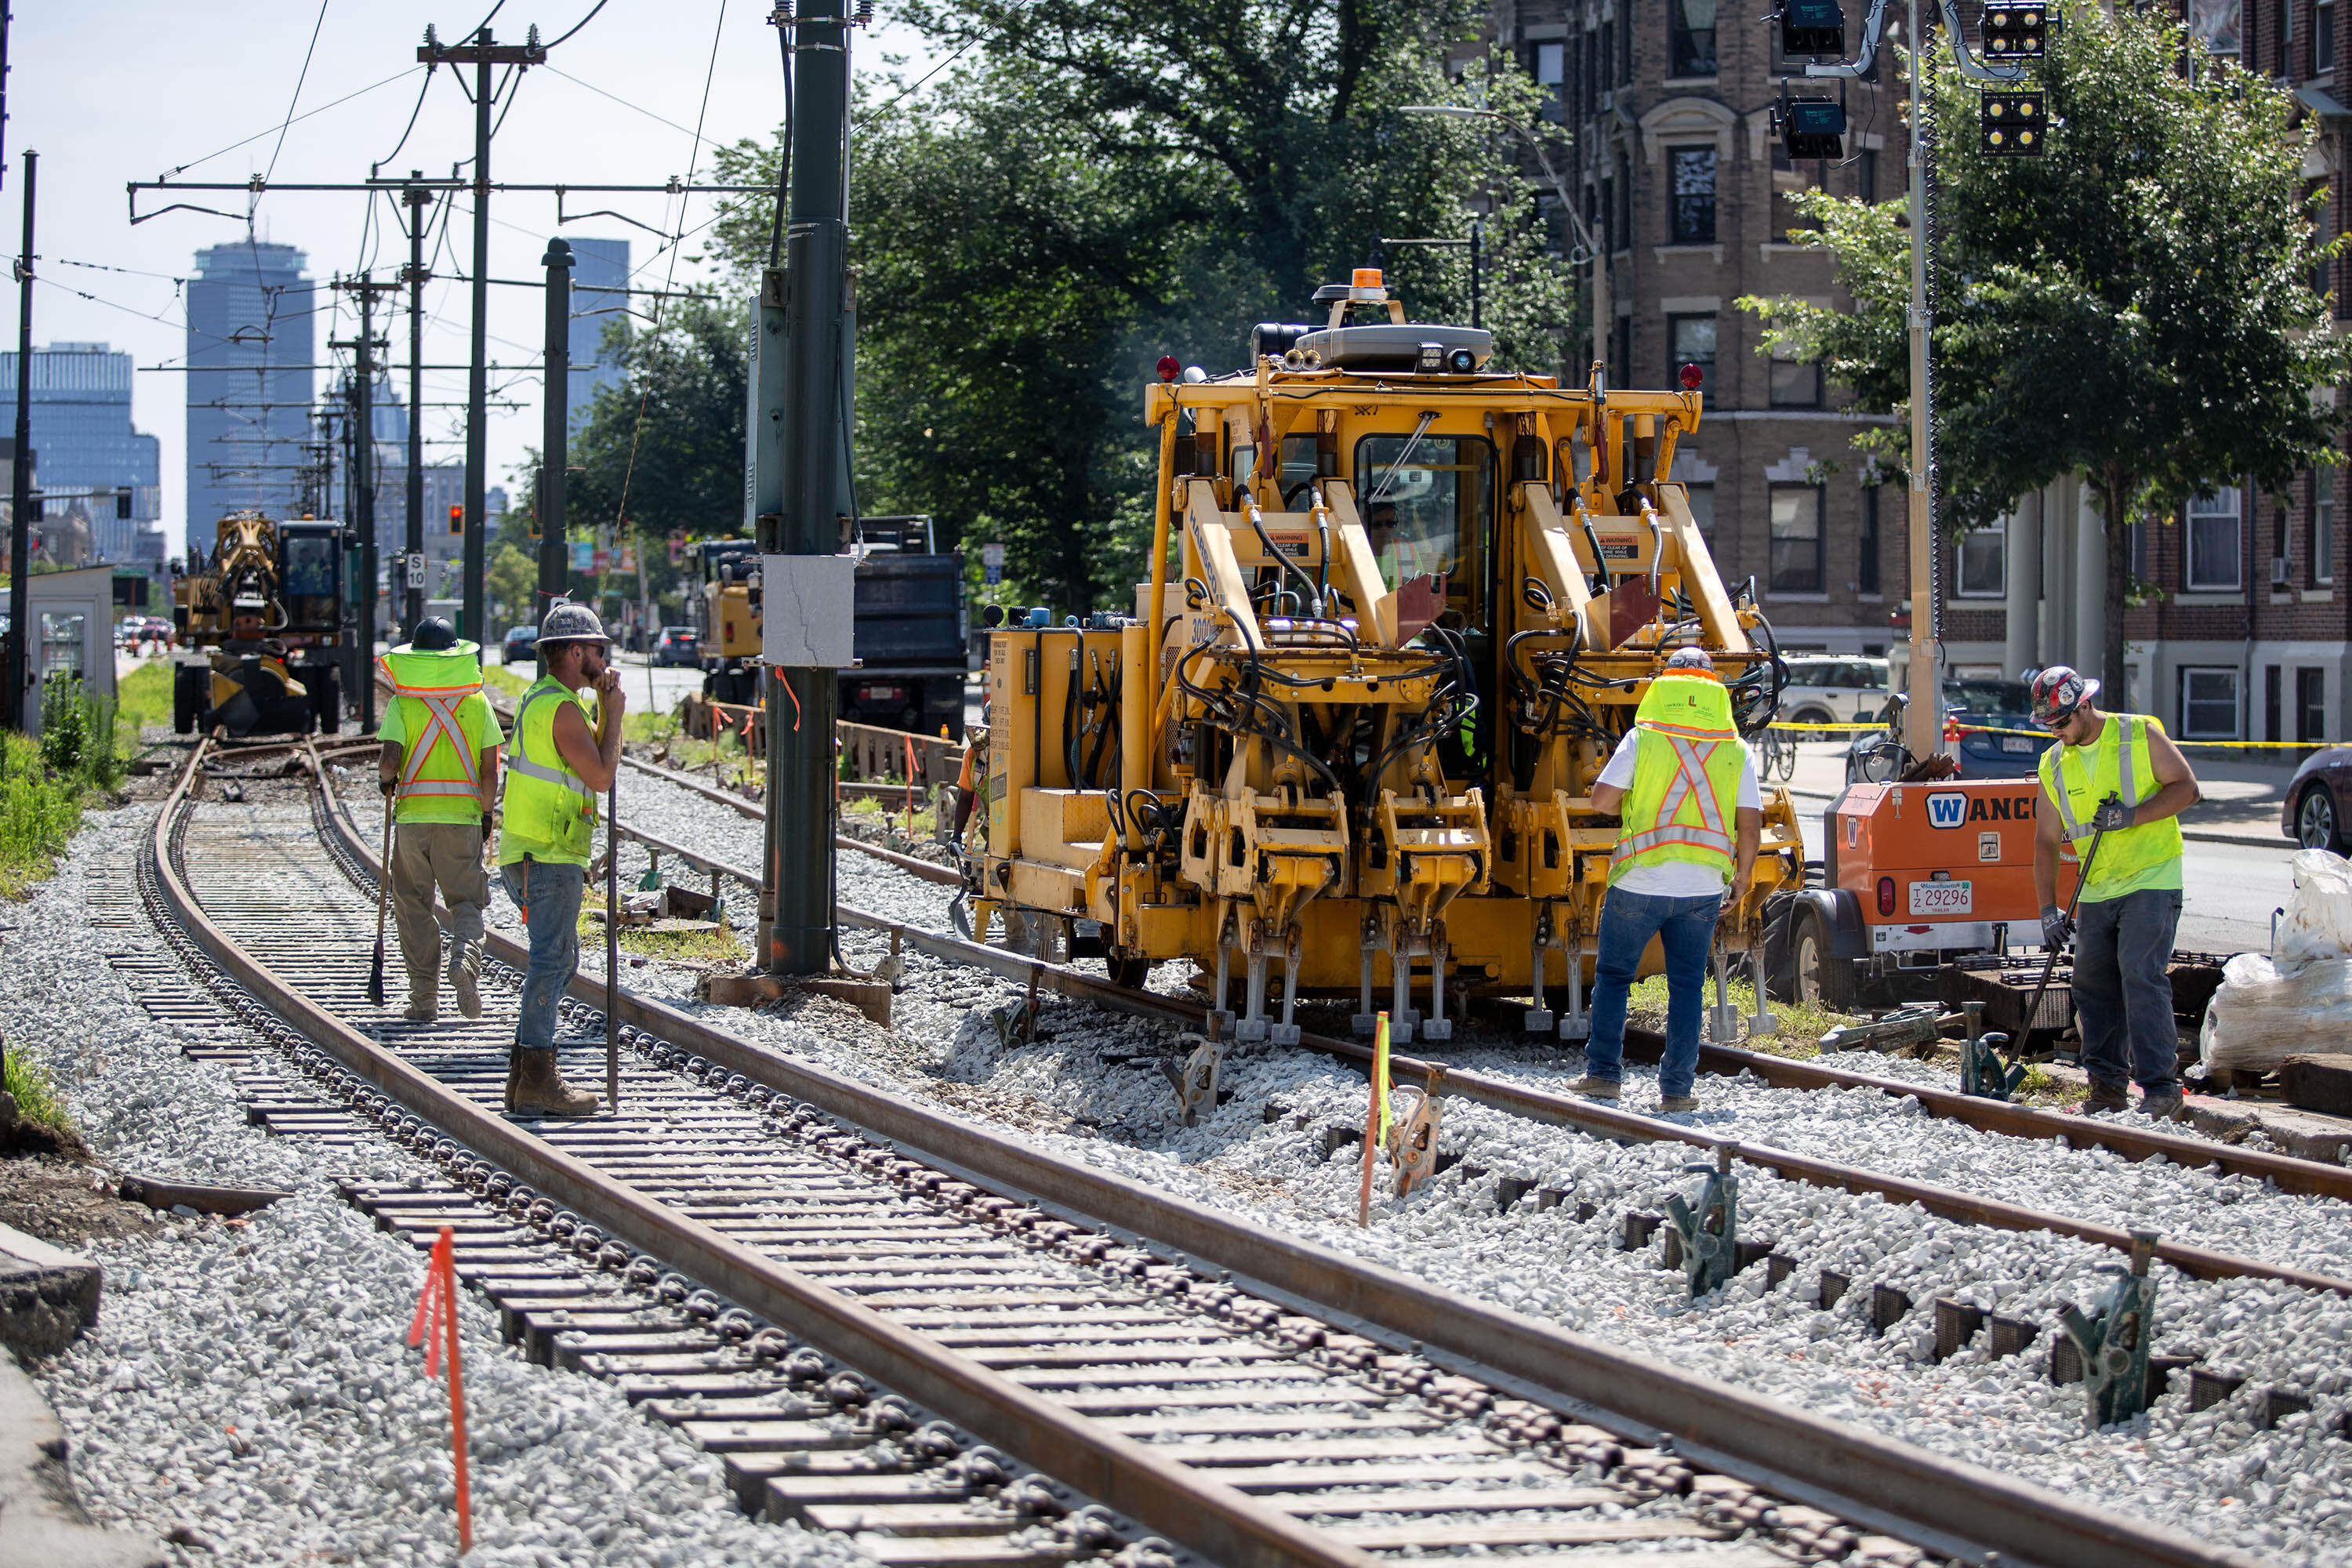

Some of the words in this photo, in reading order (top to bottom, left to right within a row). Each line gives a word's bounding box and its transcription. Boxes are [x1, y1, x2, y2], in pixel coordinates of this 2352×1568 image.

[1189, 508, 1217, 594] HARSCO
[412, 557, 421, 568] S
[409, 572, 424, 584] 10
[1932, 797, 2038, 822] WANC
[1848, 821, 1857, 844] W
[1926, 889, 1969, 906] 29296
